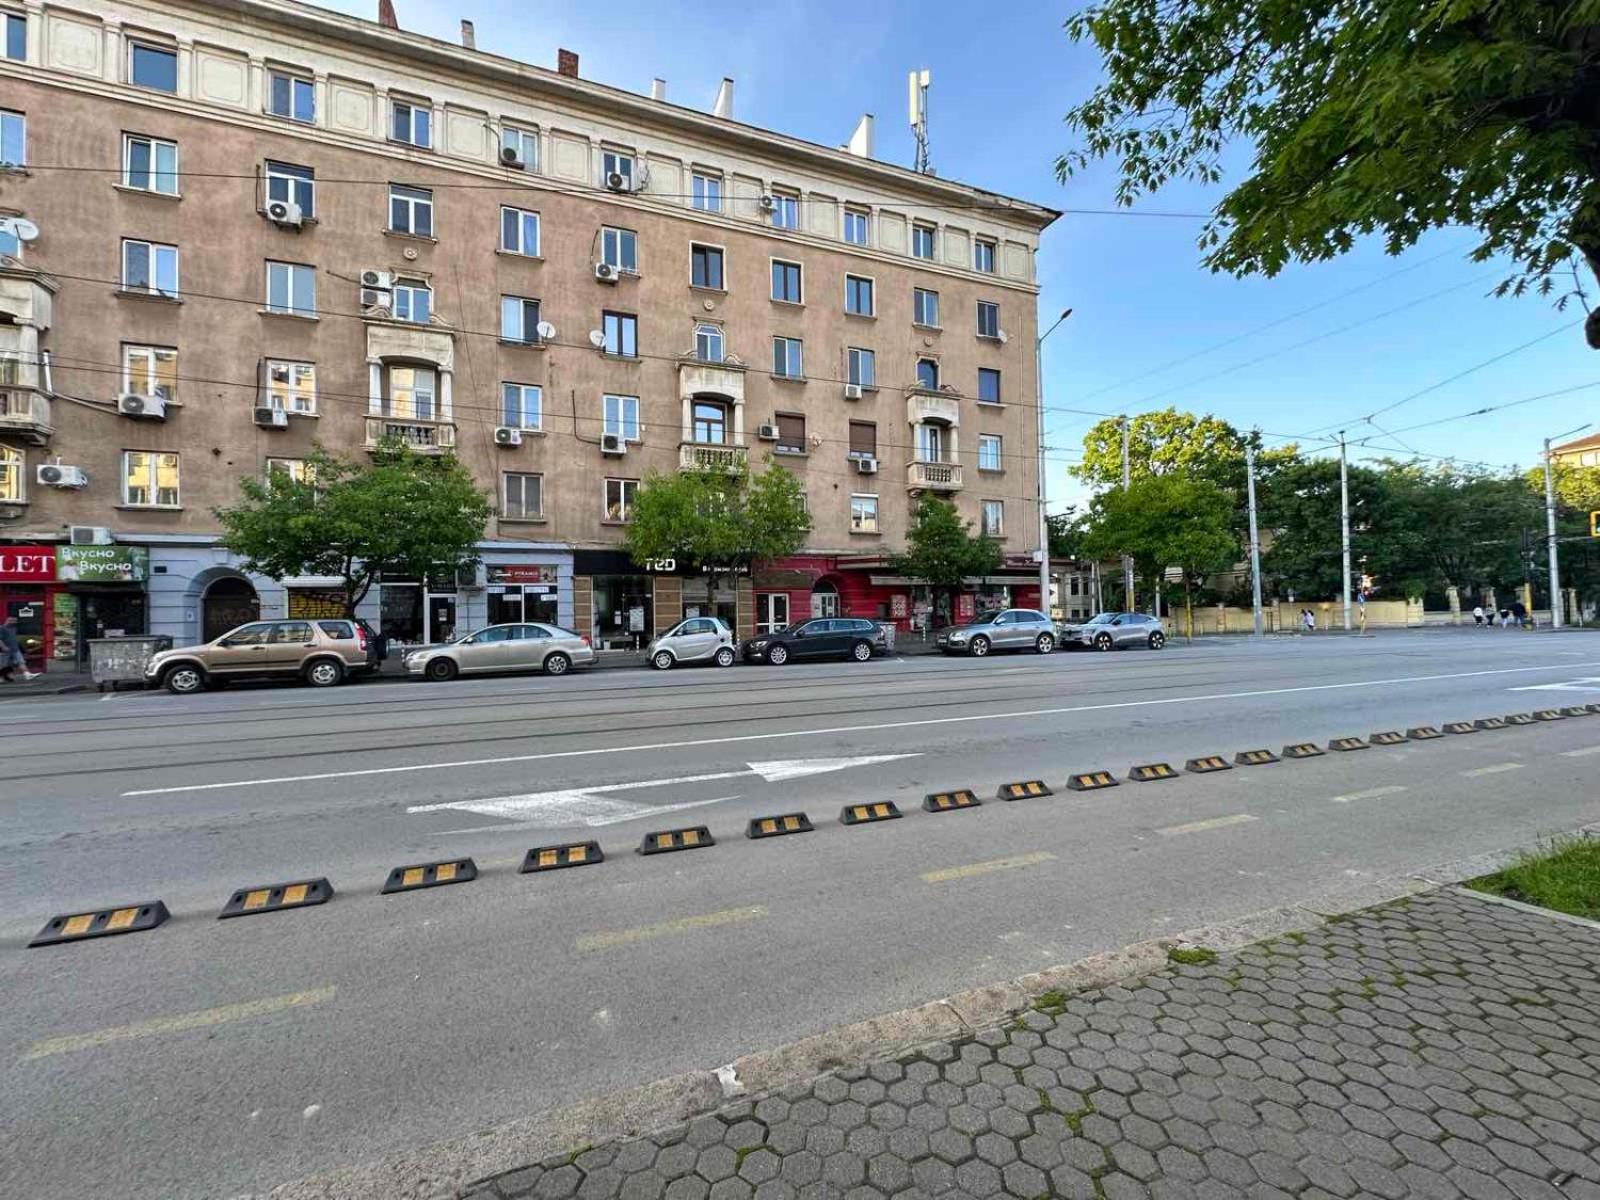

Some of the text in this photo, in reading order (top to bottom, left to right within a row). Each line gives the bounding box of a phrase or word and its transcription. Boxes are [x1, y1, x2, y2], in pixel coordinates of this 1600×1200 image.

[62, 547, 114, 560] Вкусно
[0, 555, 55, 573] LET
[80, 561, 132, 573] Вкусно
